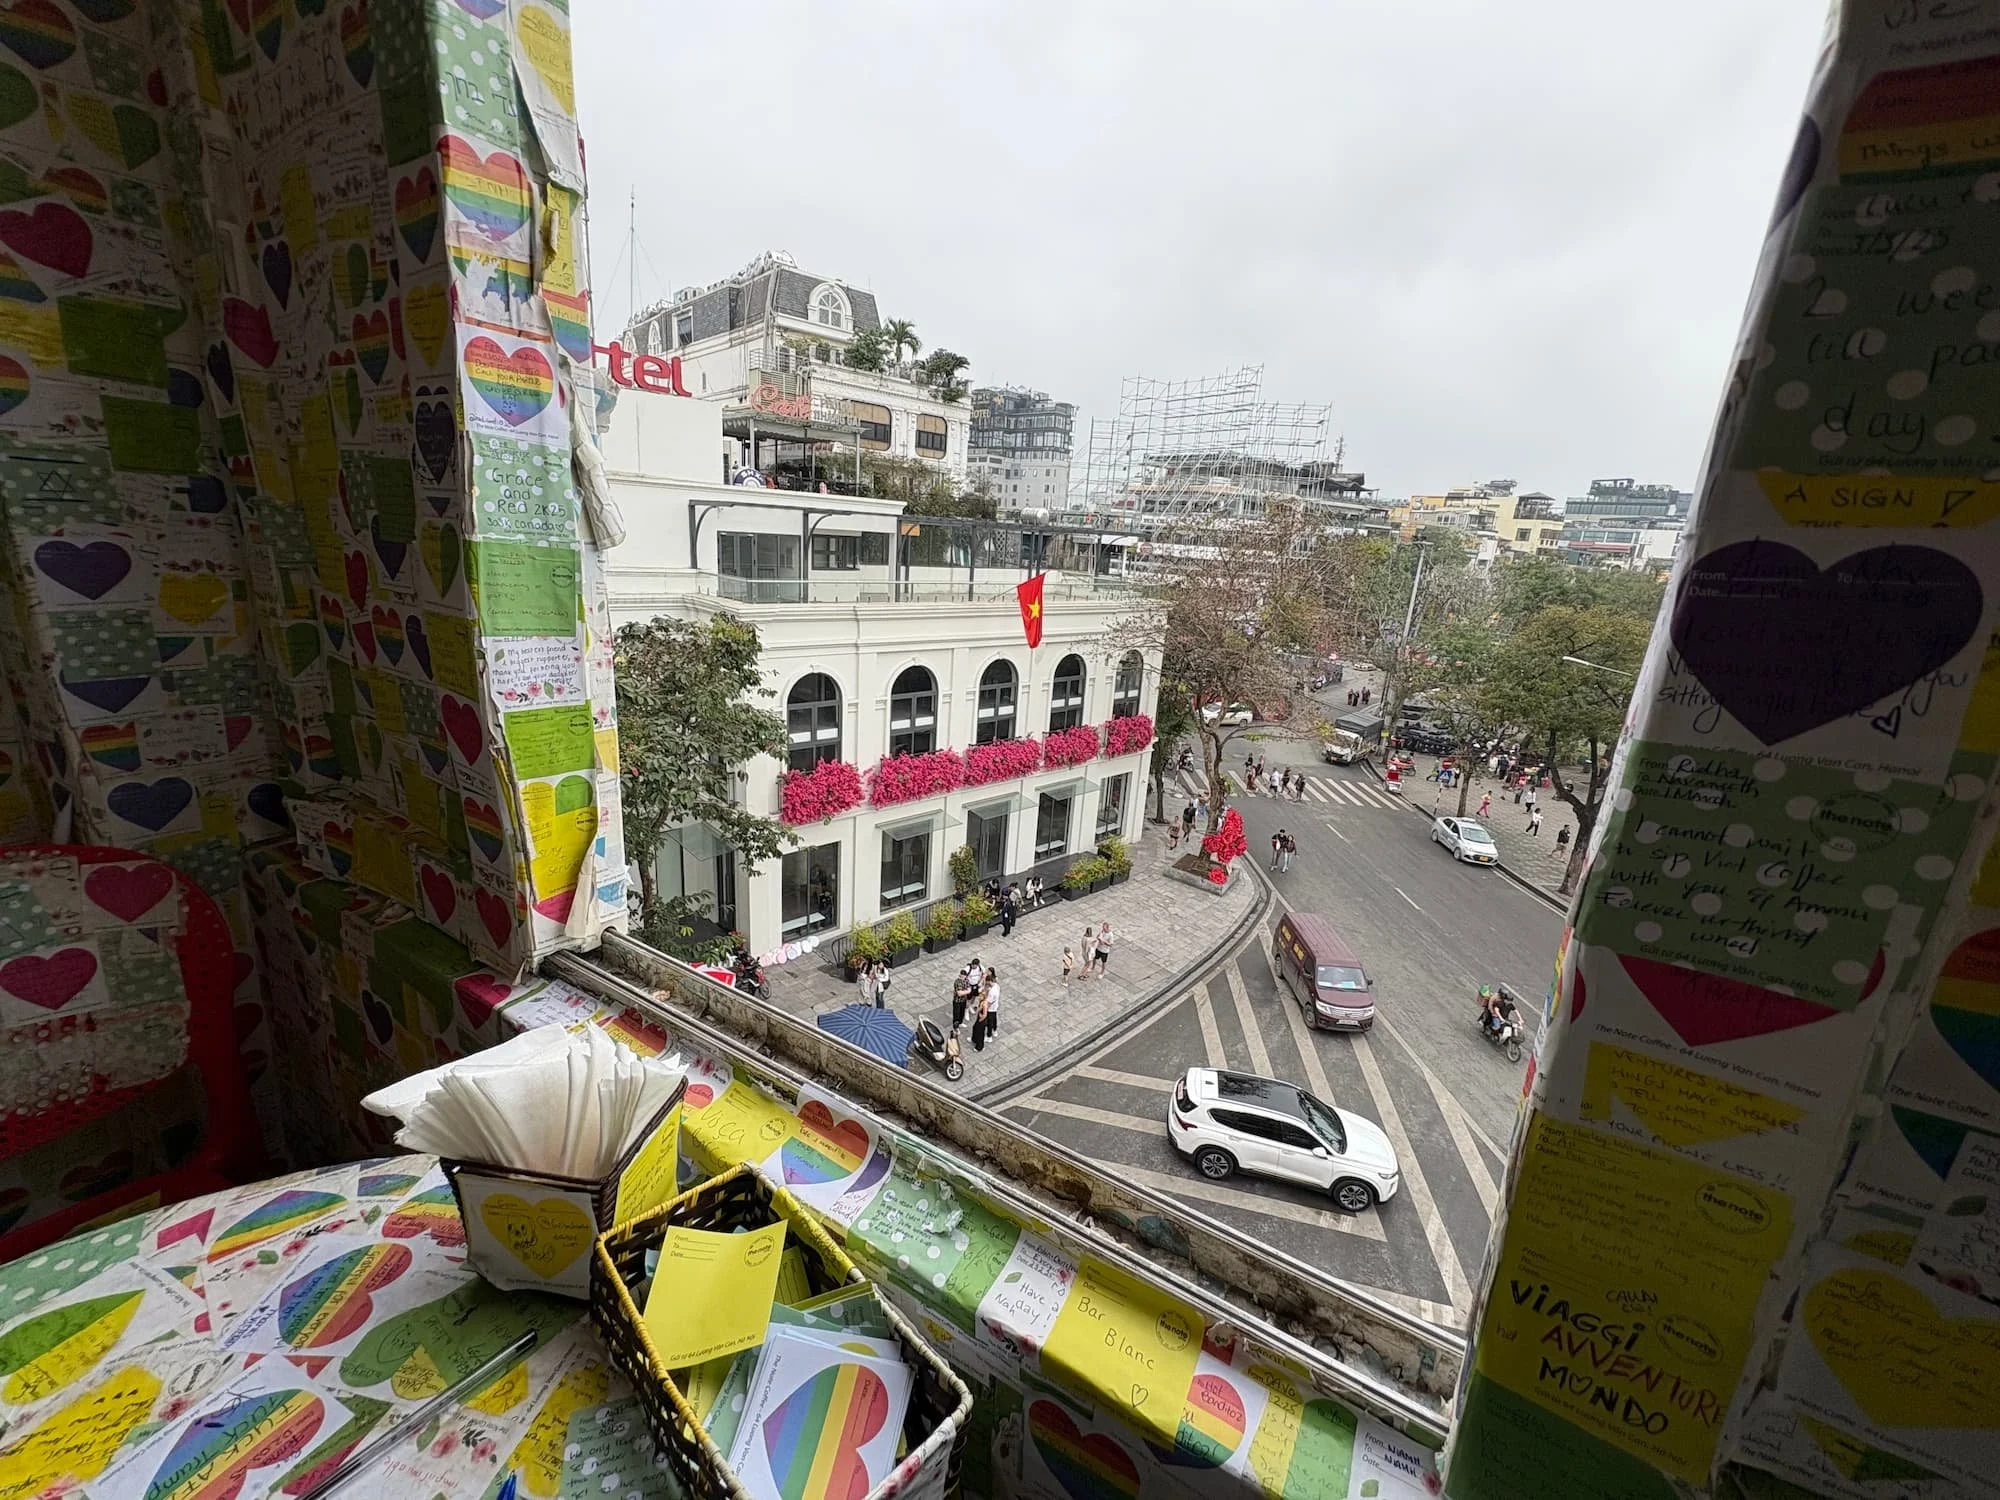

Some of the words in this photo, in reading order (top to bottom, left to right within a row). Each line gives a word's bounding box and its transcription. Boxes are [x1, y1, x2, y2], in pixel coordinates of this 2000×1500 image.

[591, 341, 692, 397] tel
[1823, 391, 1926, 455] day
[492, 467, 545, 488] Grace
[503, 488, 531, 500] and
[1784, 483, 1808, 504] A
[1830, 486, 1914, 509] SIGN
[1655, 823, 1729, 845] cannot
[1020, 1283, 1046, 1305] Have
[1077, 1296, 1106, 1322] Bar
[1104, 1328, 1155, 1371] Blanc
[1365, 1431, 1384, 1448] From
[1361, 1454, 1380, 1468] Date
